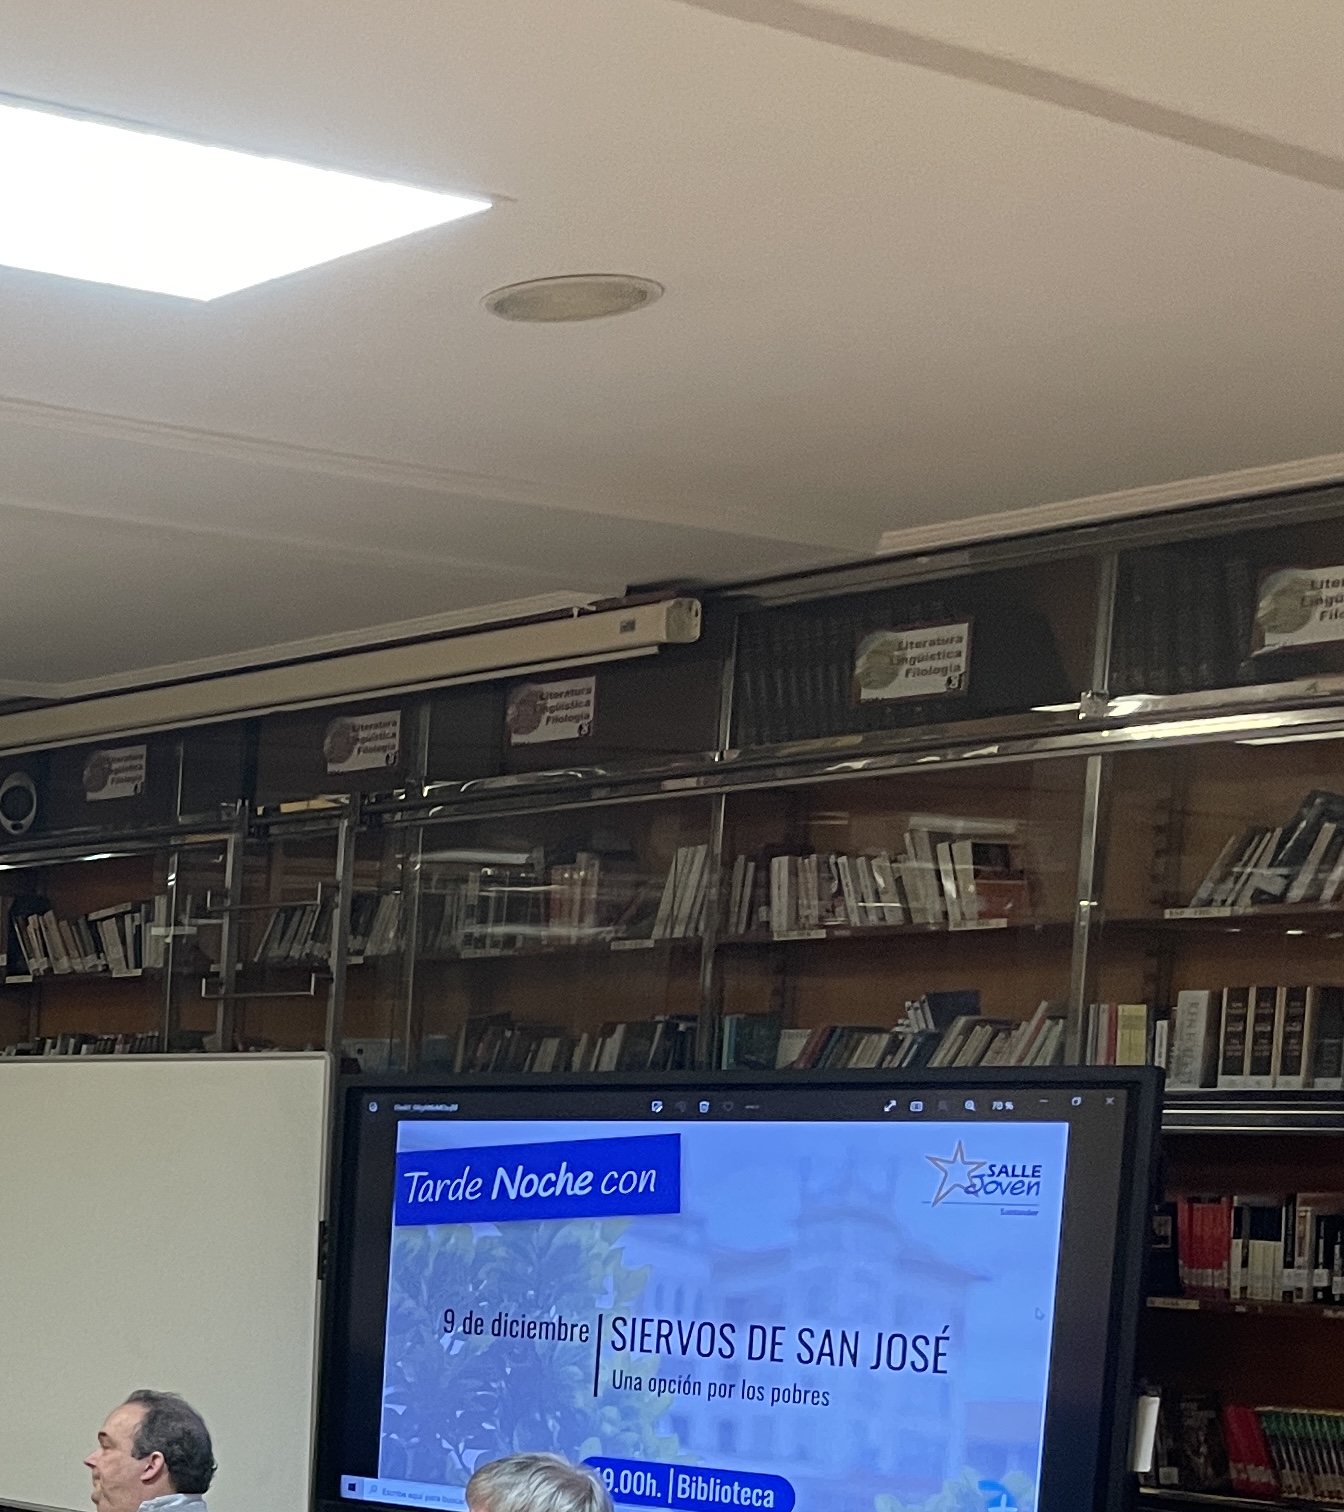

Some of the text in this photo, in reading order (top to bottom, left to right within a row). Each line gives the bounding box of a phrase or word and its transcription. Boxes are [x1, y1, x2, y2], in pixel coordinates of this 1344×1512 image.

[897, 635, 963, 651] Literatura
[403, 1161, 656, 1204] Tarde Noche con
[964, 1174, 1041, 1197] Joven
[987, 1163, 1043, 1179] SALLE
[443, 1308, 590, 1343] 9 de diciembre
[611, 1315, 951, 1375] SIERVOS DE SAN JOSÉ
[612, 1369, 830, 1408] Una opción por los pobres
[677, 1474, 775, 1509] Biblioteca
